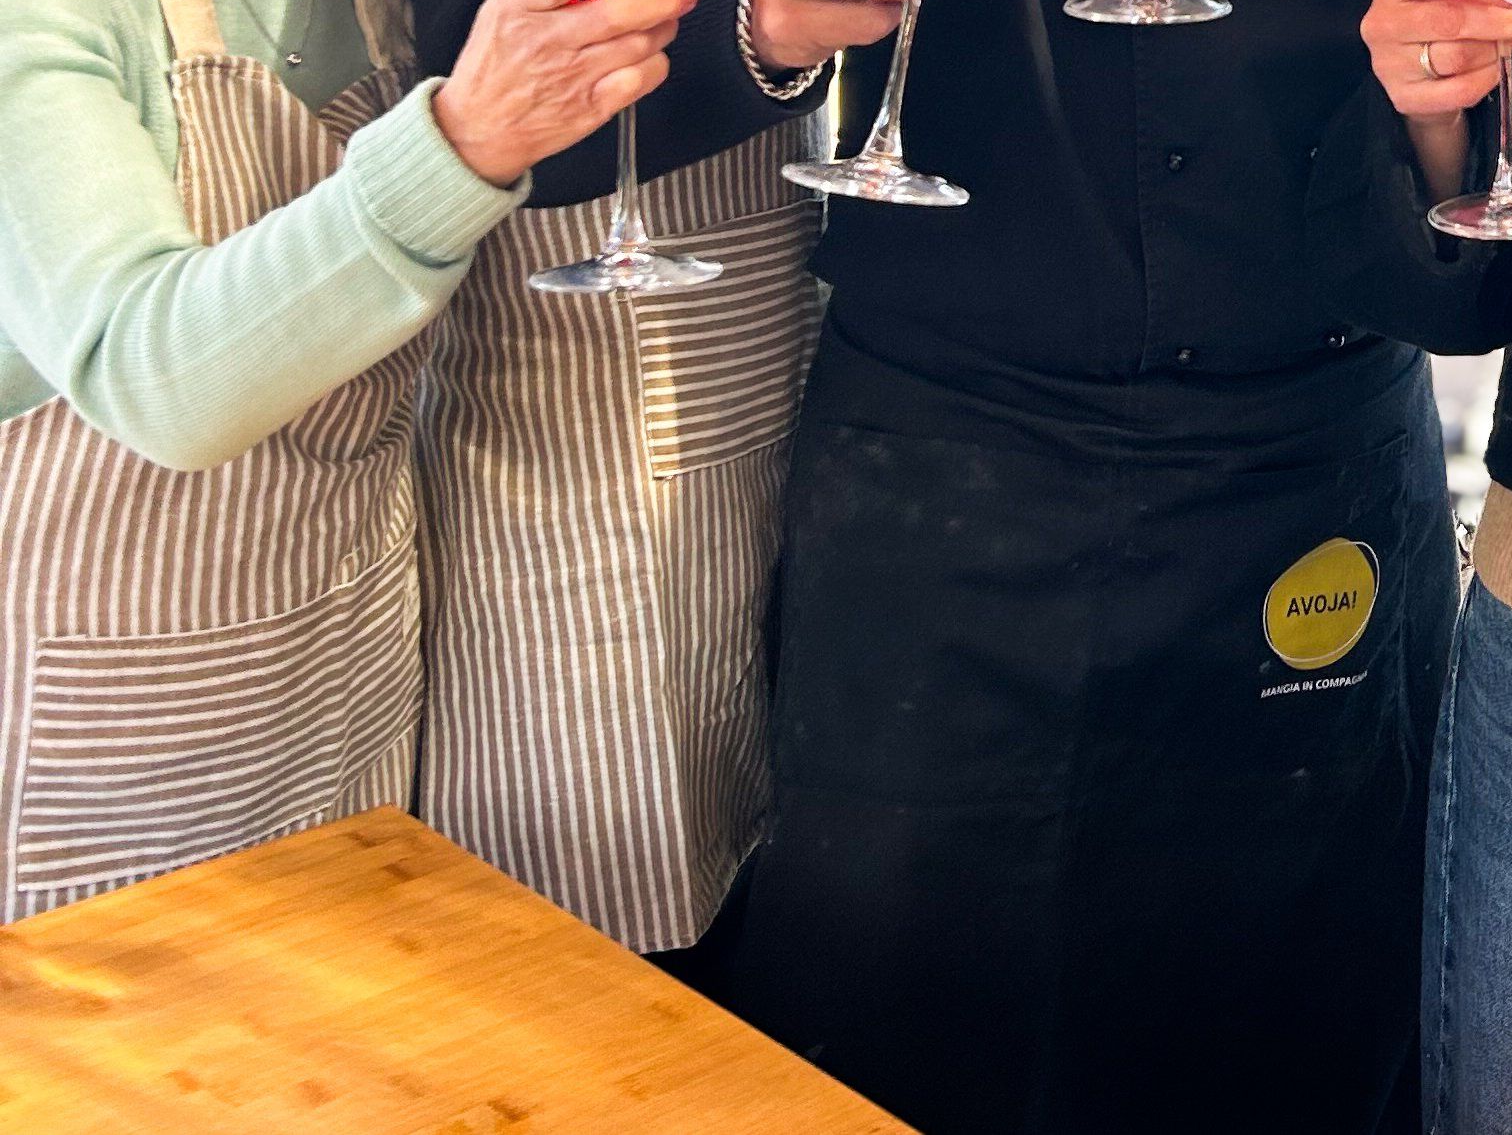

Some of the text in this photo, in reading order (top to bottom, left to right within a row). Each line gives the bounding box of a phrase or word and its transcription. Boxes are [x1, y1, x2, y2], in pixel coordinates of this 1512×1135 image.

[1286, 590, 1358, 618] AVOJA!
[1260, 682, 1301, 699] MANGIA
[1302, 680, 1314, 691] IN
